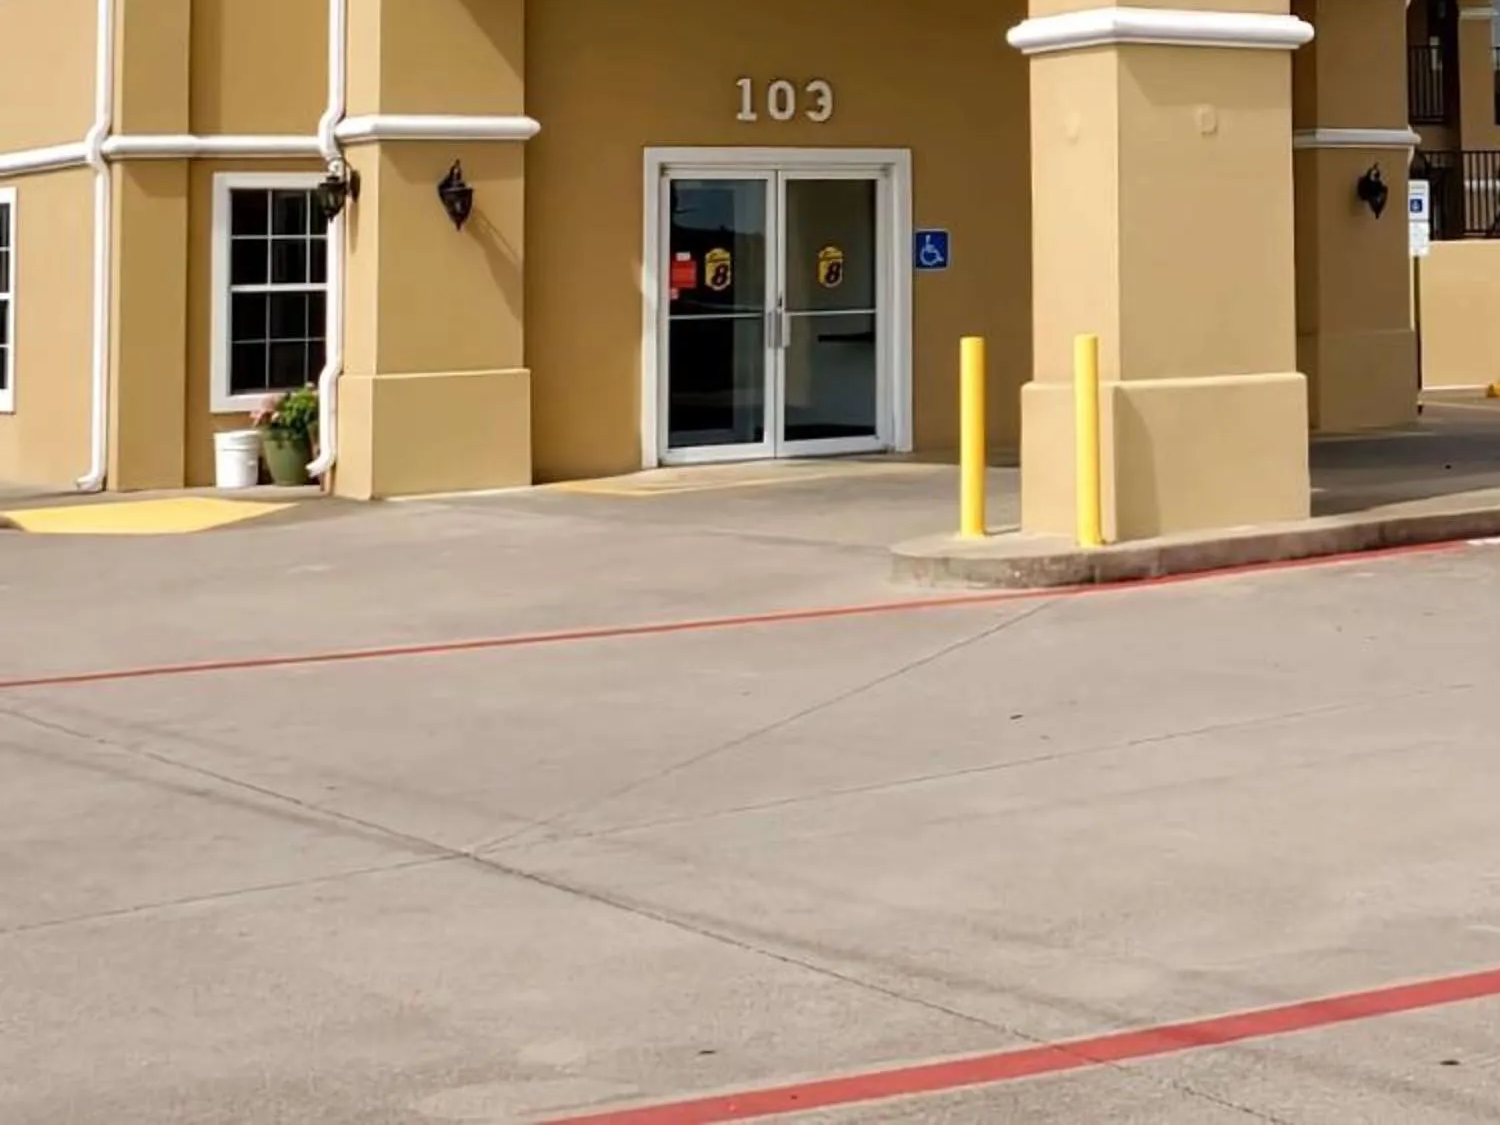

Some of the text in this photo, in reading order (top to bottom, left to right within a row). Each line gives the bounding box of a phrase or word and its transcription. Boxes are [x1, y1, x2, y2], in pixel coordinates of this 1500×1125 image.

[736, 78, 833, 122] 103
[711, 263, 729, 287] 8
[824, 261, 841, 285] 8
